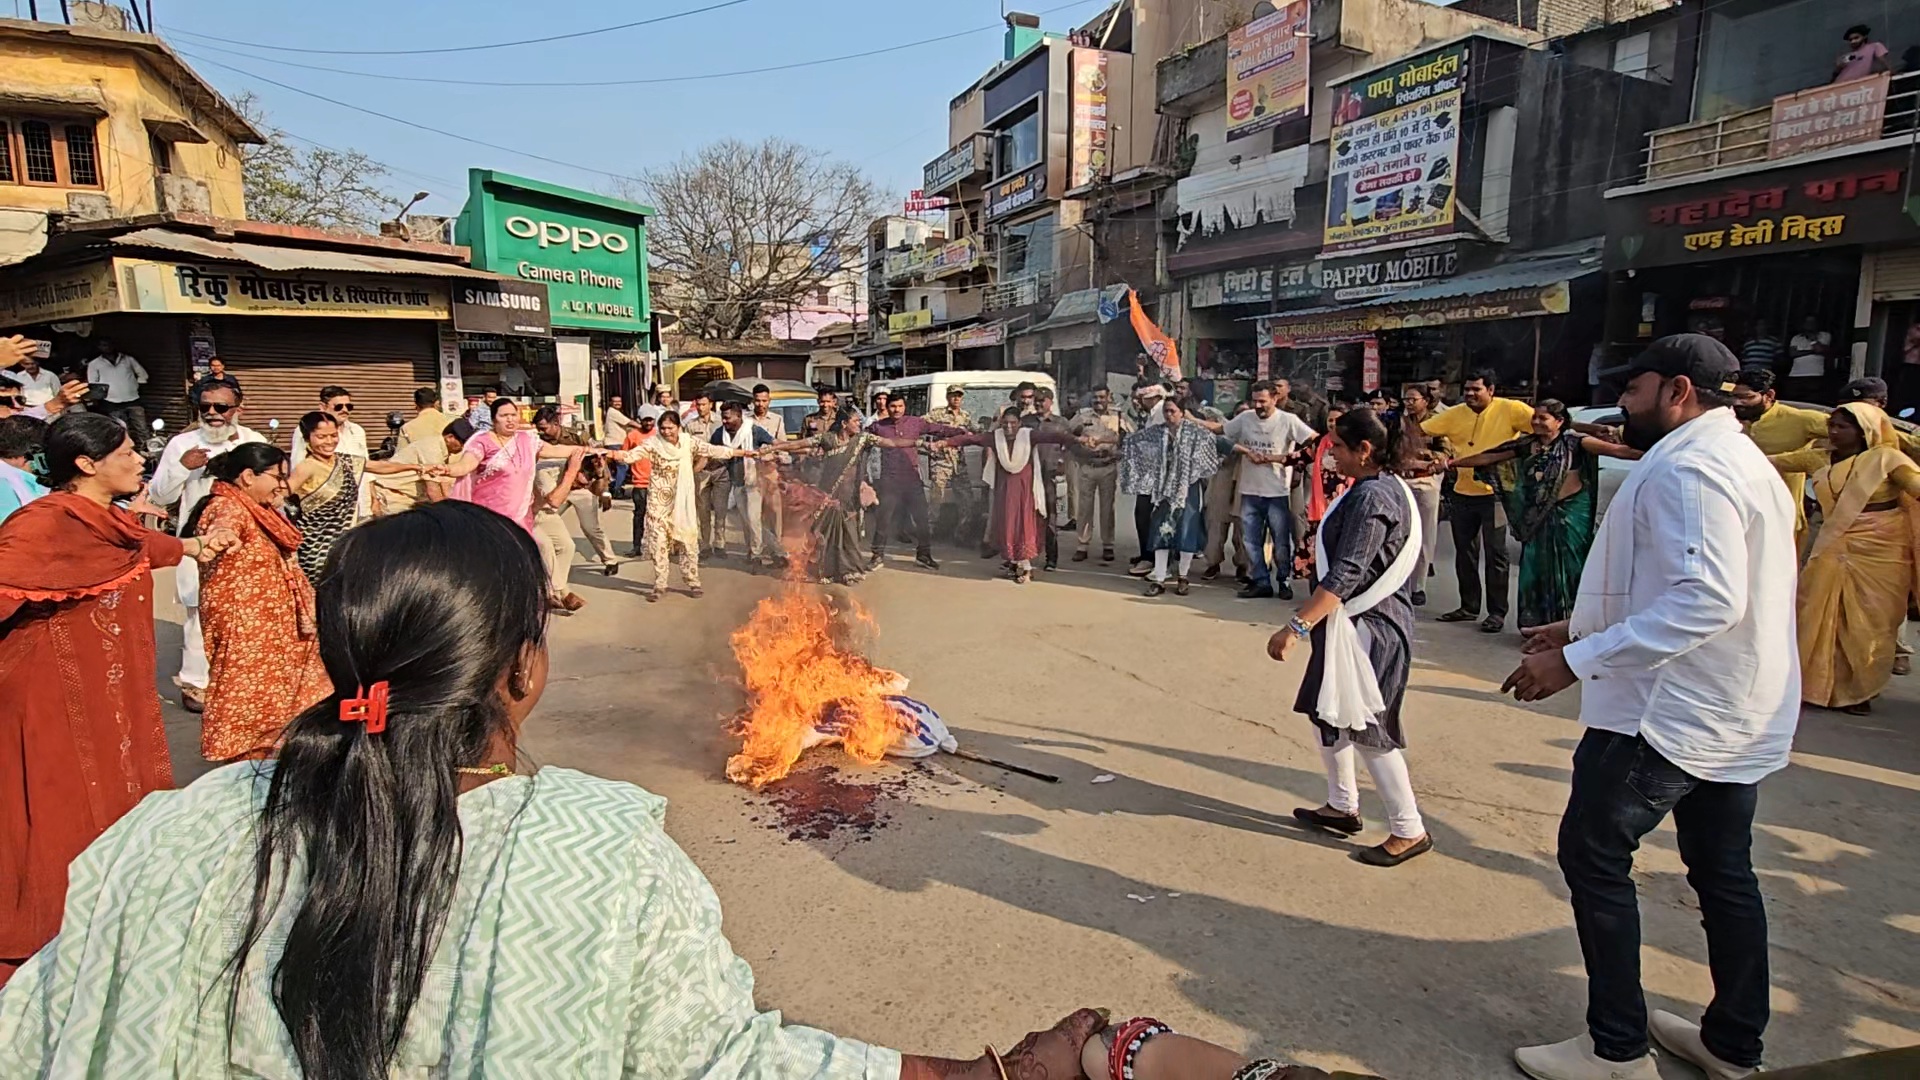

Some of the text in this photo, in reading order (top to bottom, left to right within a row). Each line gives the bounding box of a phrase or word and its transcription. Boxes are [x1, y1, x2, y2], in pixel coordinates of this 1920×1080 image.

[1368, 76, 1394, 98] पप्पू
[1399, 54, 1459, 88] मोबाईल
[1650, 169, 1905, 226] महादेव पान
[1730, 218, 1775, 246] डेली
[518, 261, 623, 289] Camera Phone
[1322, 252, 1457, 288] PAPPU MOBILE
[235, 269, 328, 305] मोबाईल
[333, 287, 344, 303] &
[465, 289, 541, 311] SAMSUNG
[598, 302, 635, 317] MOBILE
